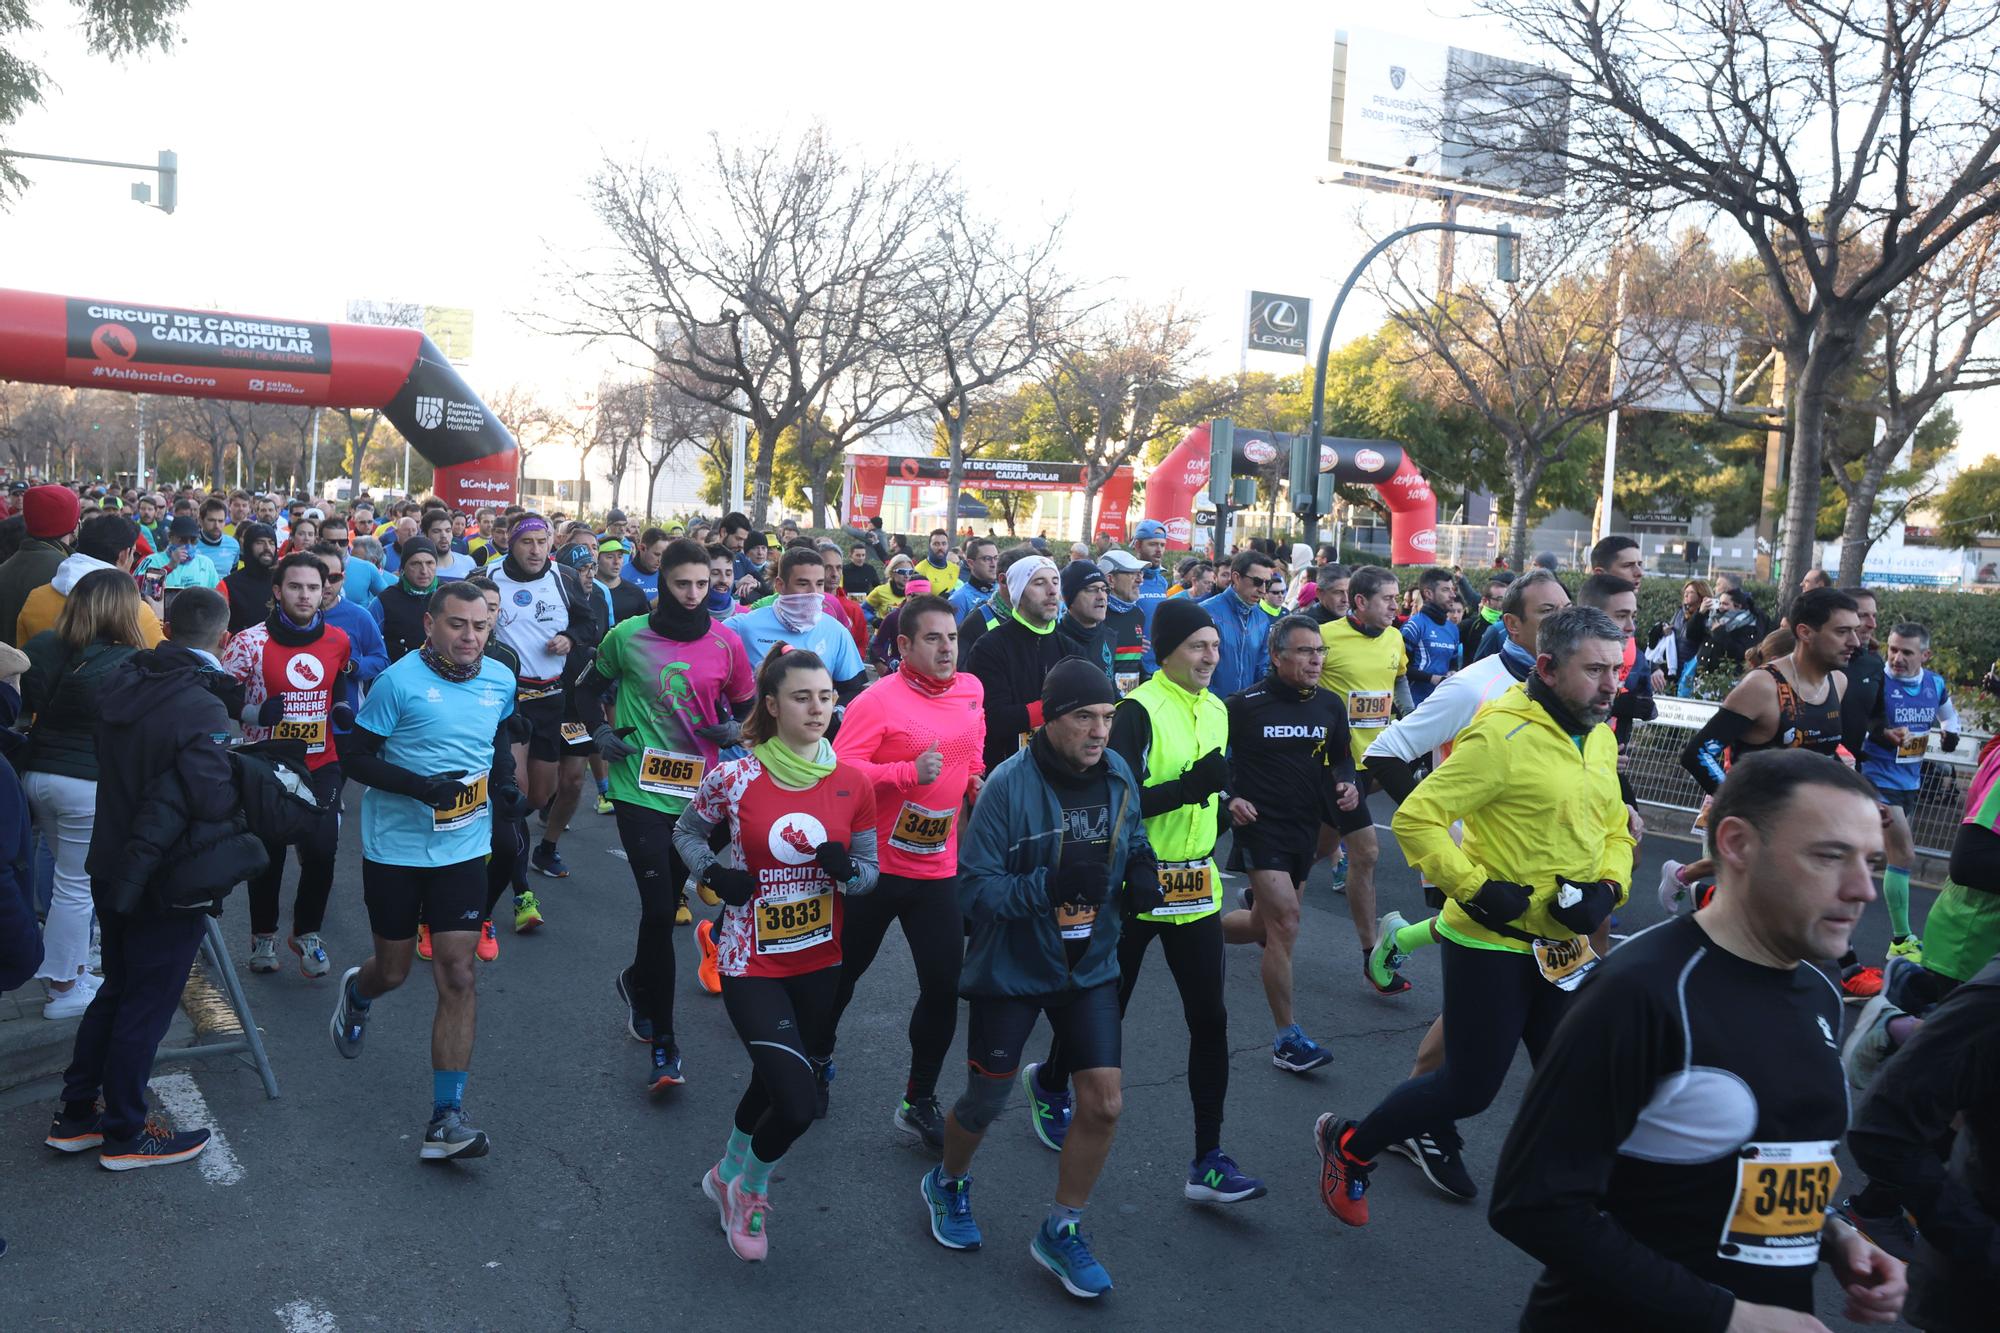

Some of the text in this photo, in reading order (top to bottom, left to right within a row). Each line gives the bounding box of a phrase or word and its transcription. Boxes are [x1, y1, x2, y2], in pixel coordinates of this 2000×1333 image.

[1372, 95, 1418, 111] PEUGEOT
[88, 306, 310, 339] CIRCUIT DE CARRERES
[1253, 333, 1305, 348] LEXUS
[92, 366, 217, 387] #ValènciaCorre
[266, 385, 305, 395] popular
[280, 689, 328, 702] CIRCUIT DE
[1356, 698, 1386, 714] 3798
[1894, 707, 1935, 716] POBLATS
[280, 722, 319, 739] 3523
[648, 757, 694, 780] 3865
[904, 813, 948, 837] 3434
[759, 866, 815, 883] CIRCUIT
[1162, 870, 1204, 894] 3446
[765, 899, 821, 931] 3833
[1754, 1166, 1830, 1216] 3453
